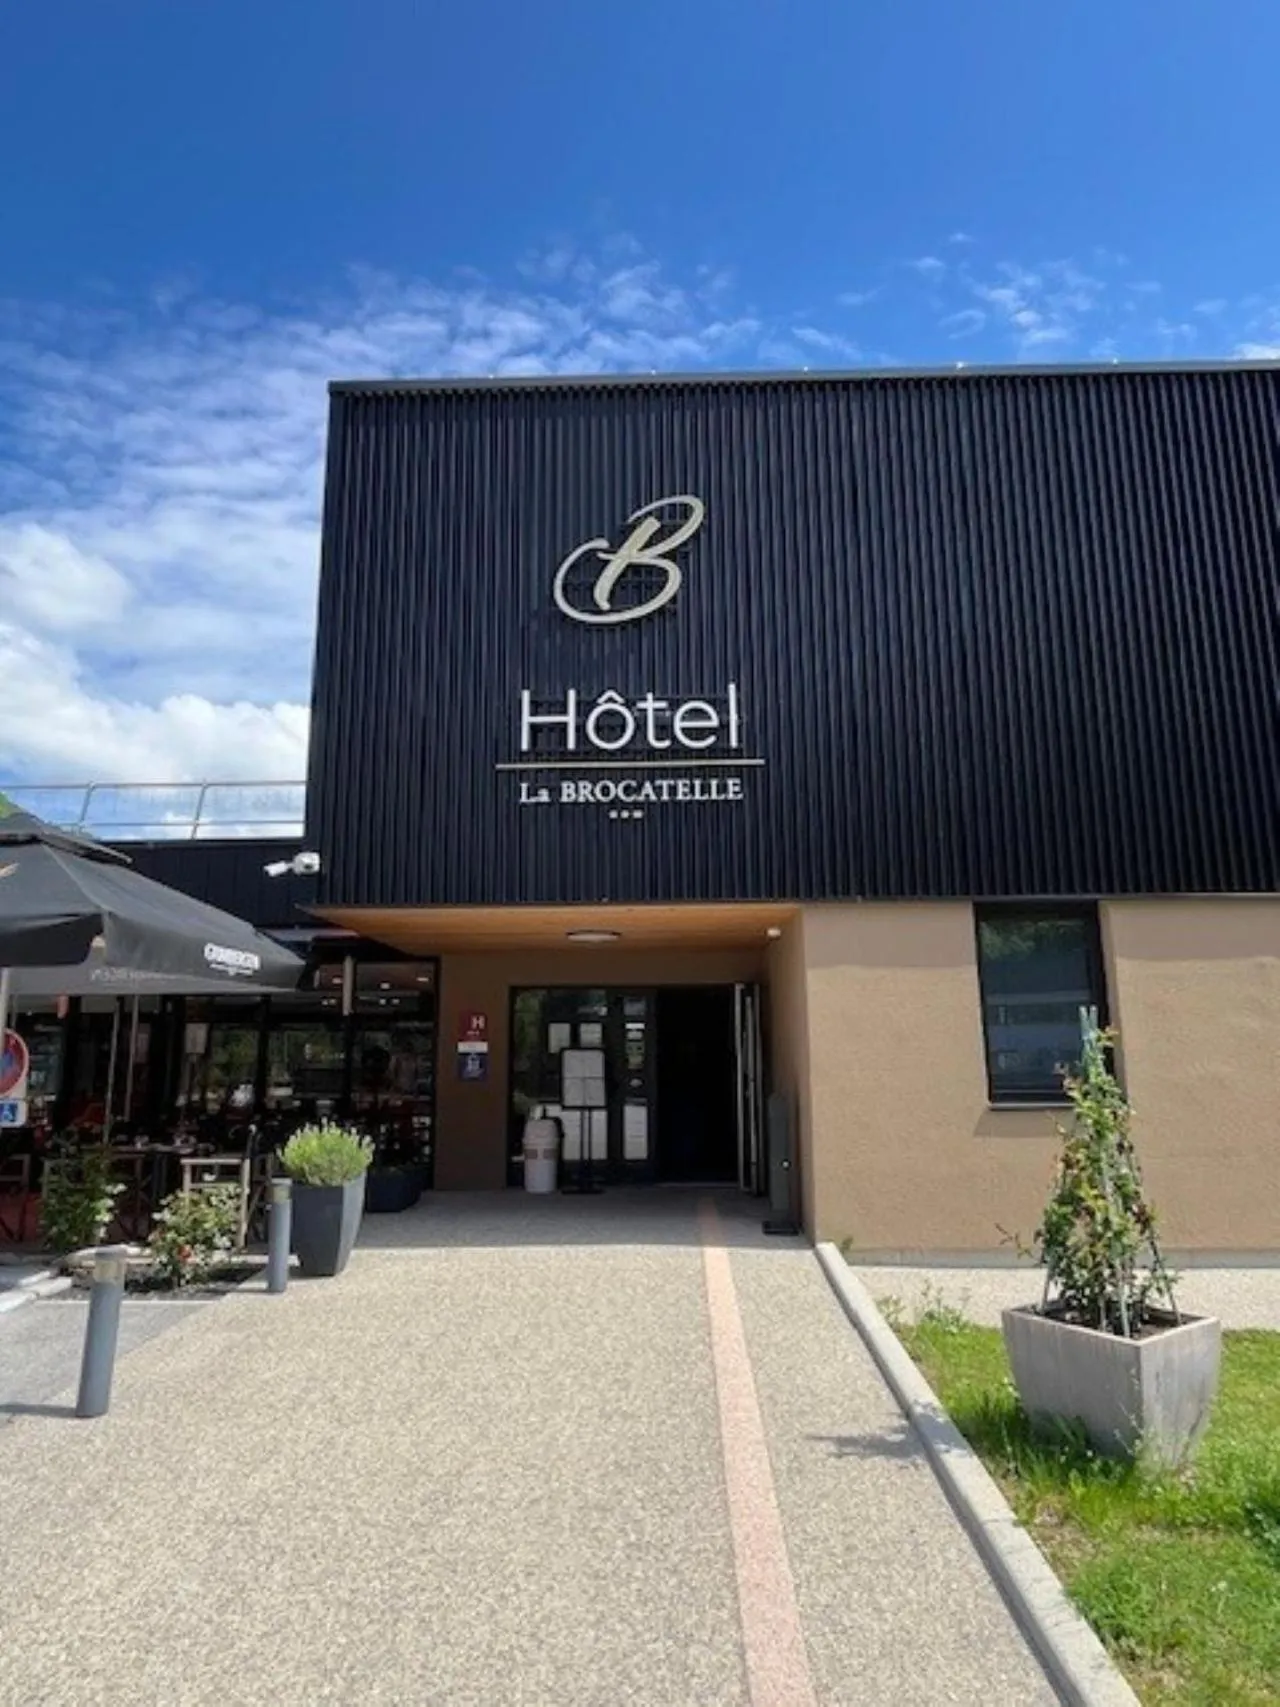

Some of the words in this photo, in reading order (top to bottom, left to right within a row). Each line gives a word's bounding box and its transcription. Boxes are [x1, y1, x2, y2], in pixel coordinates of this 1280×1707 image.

[553, 494, 705, 624] B
[520, 682, 738, 752] Hôtel
[520, 782, 551, 803] La
[560, 778, 744, 803] BROCATELLE
[471, 1014, 486, 1030] H
